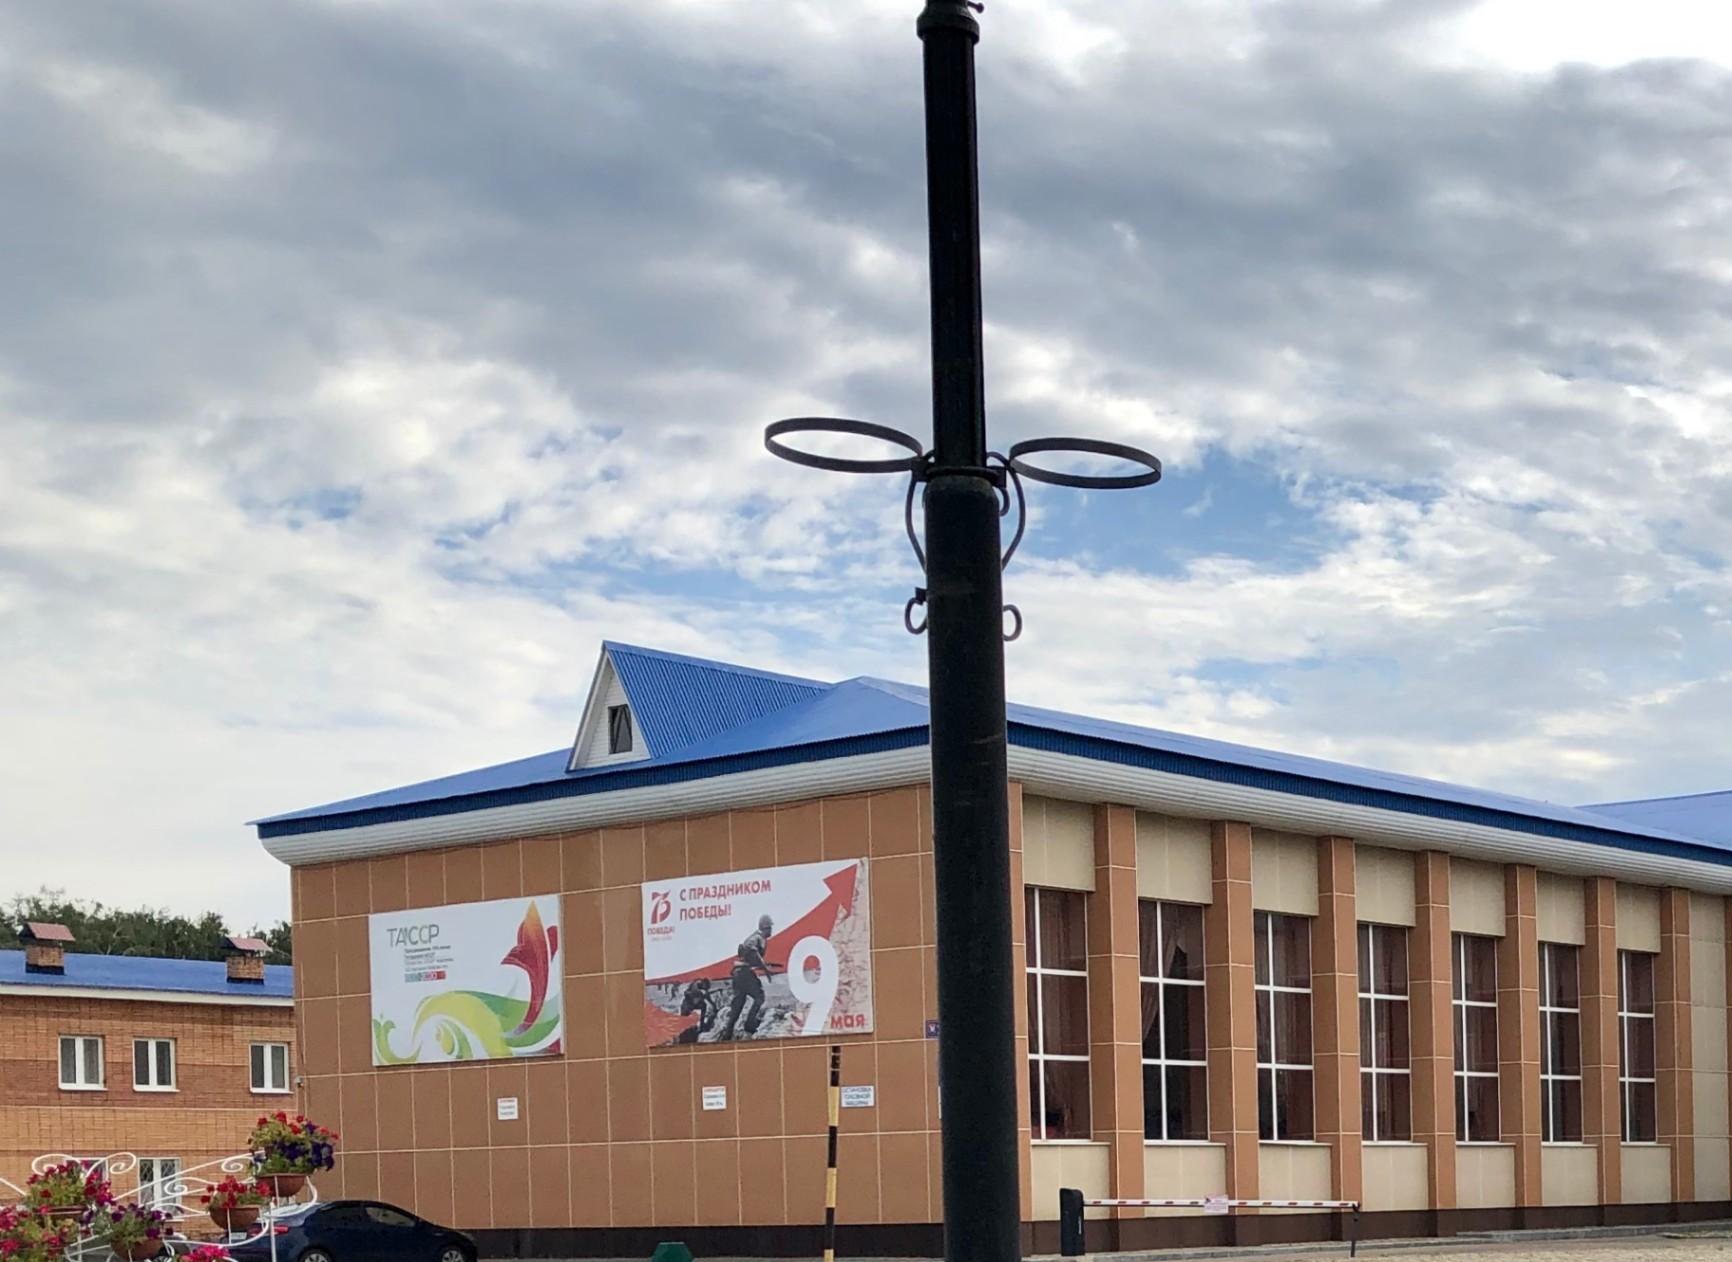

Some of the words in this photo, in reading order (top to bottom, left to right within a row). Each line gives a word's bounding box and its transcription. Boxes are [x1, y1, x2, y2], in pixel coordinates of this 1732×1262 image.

[679, 888, 687, 901] С
[689, 880, 771, 900] ПРАЗДНИКОМ
[680, 904, 732, 920] ПОБЕДЫ!
[787, 935, 839, 1035] 9
[831, 1014, 865, 1029] мая
